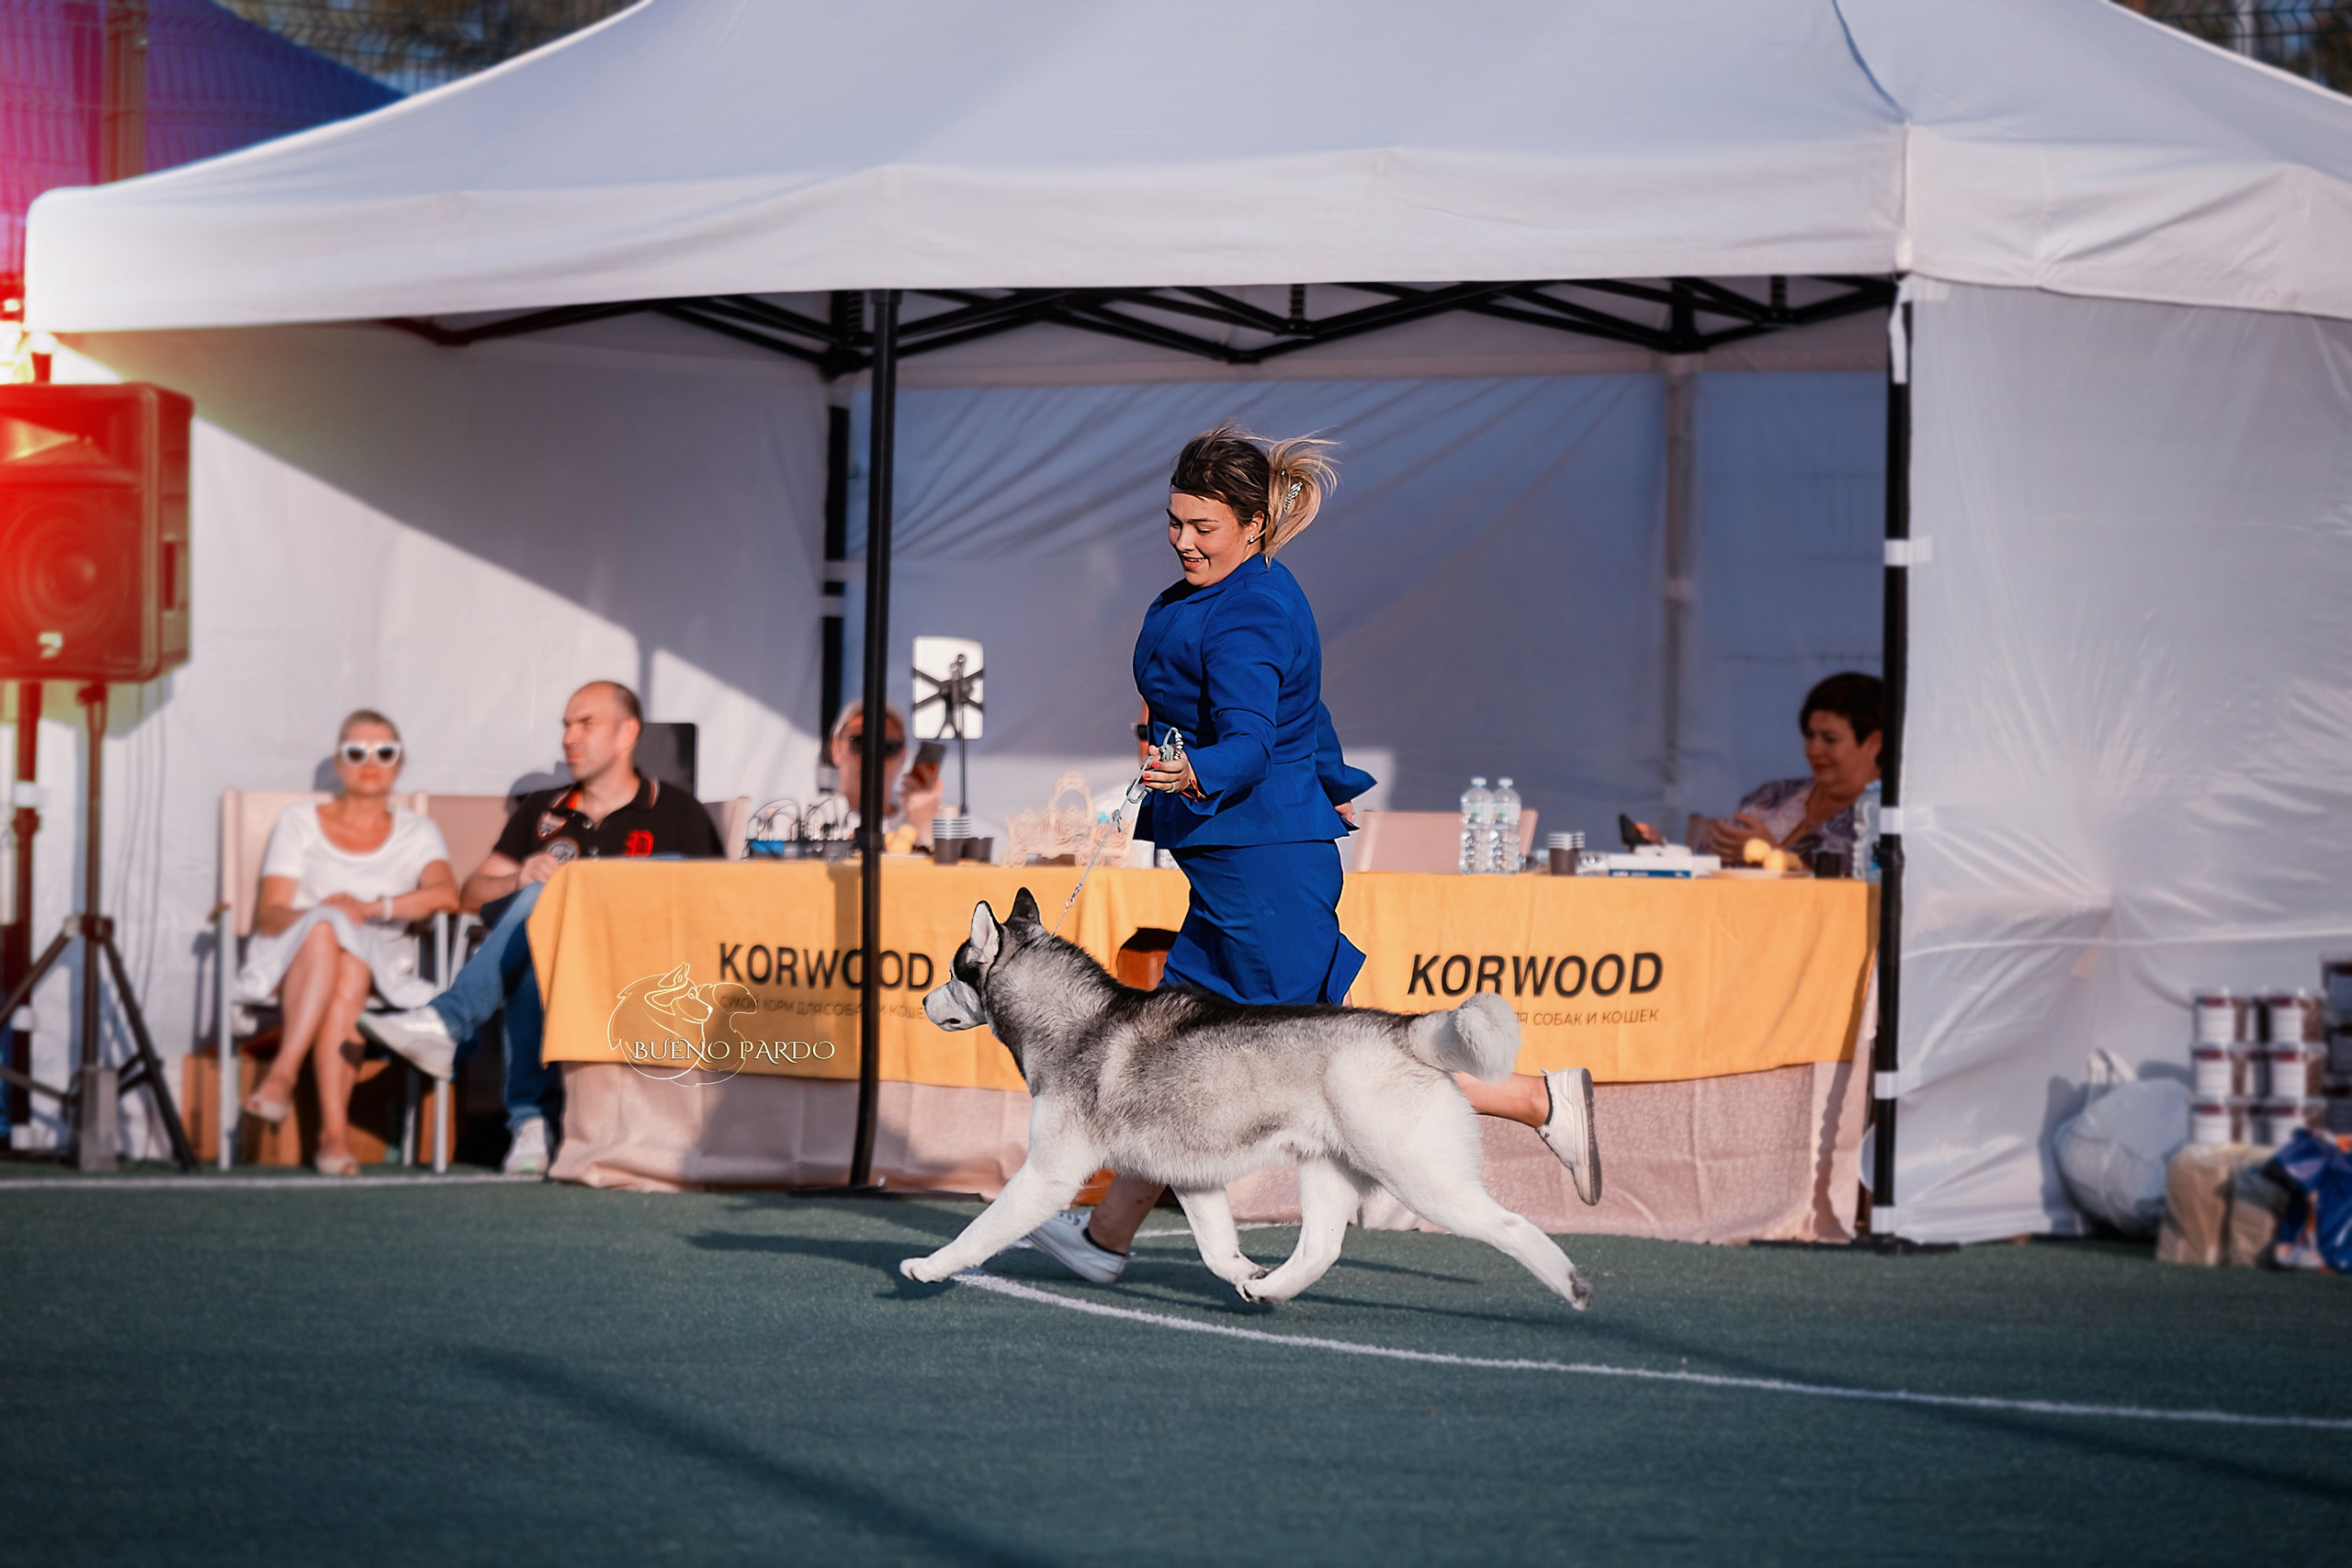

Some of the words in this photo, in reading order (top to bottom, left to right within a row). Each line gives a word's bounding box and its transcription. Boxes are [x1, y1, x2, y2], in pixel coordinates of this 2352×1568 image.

[719, 942, 935, 991] KORWOOD
[1408, 952, 1664, 998] KORWOOD
[889, 1004, 926, 1021] КОШЕ
[1532, 1011, 1583, 1026] СОБАК
[1586, 1011, 1598, 1025] И
[1601, 1008, 1659, 1025] КОШЕК
